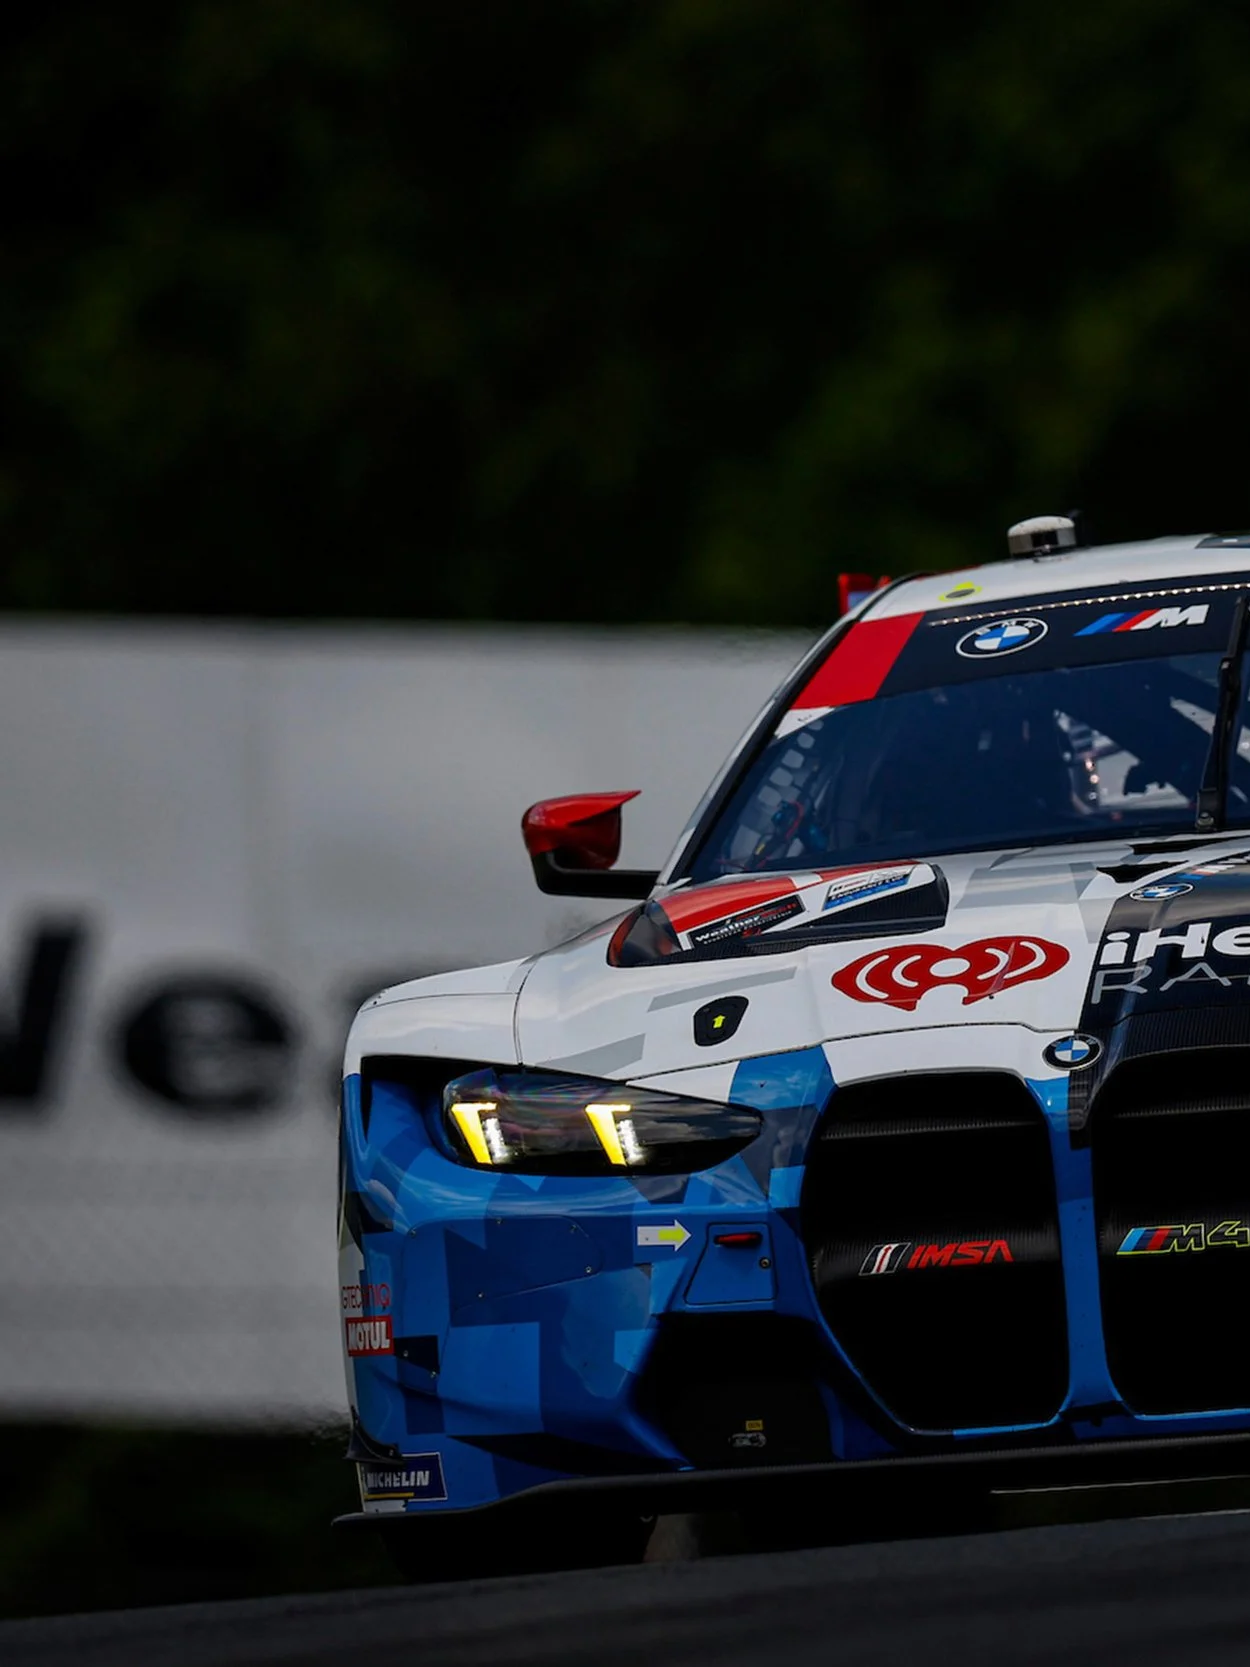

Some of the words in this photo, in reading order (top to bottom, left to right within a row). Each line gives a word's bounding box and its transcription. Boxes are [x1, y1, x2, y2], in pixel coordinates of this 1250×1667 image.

[906, 1239, 1015, 1271] IMSA
[347, 1320, 391, 1352] MOTUL
[366, 1469, 431, 1490] MICHELIN
